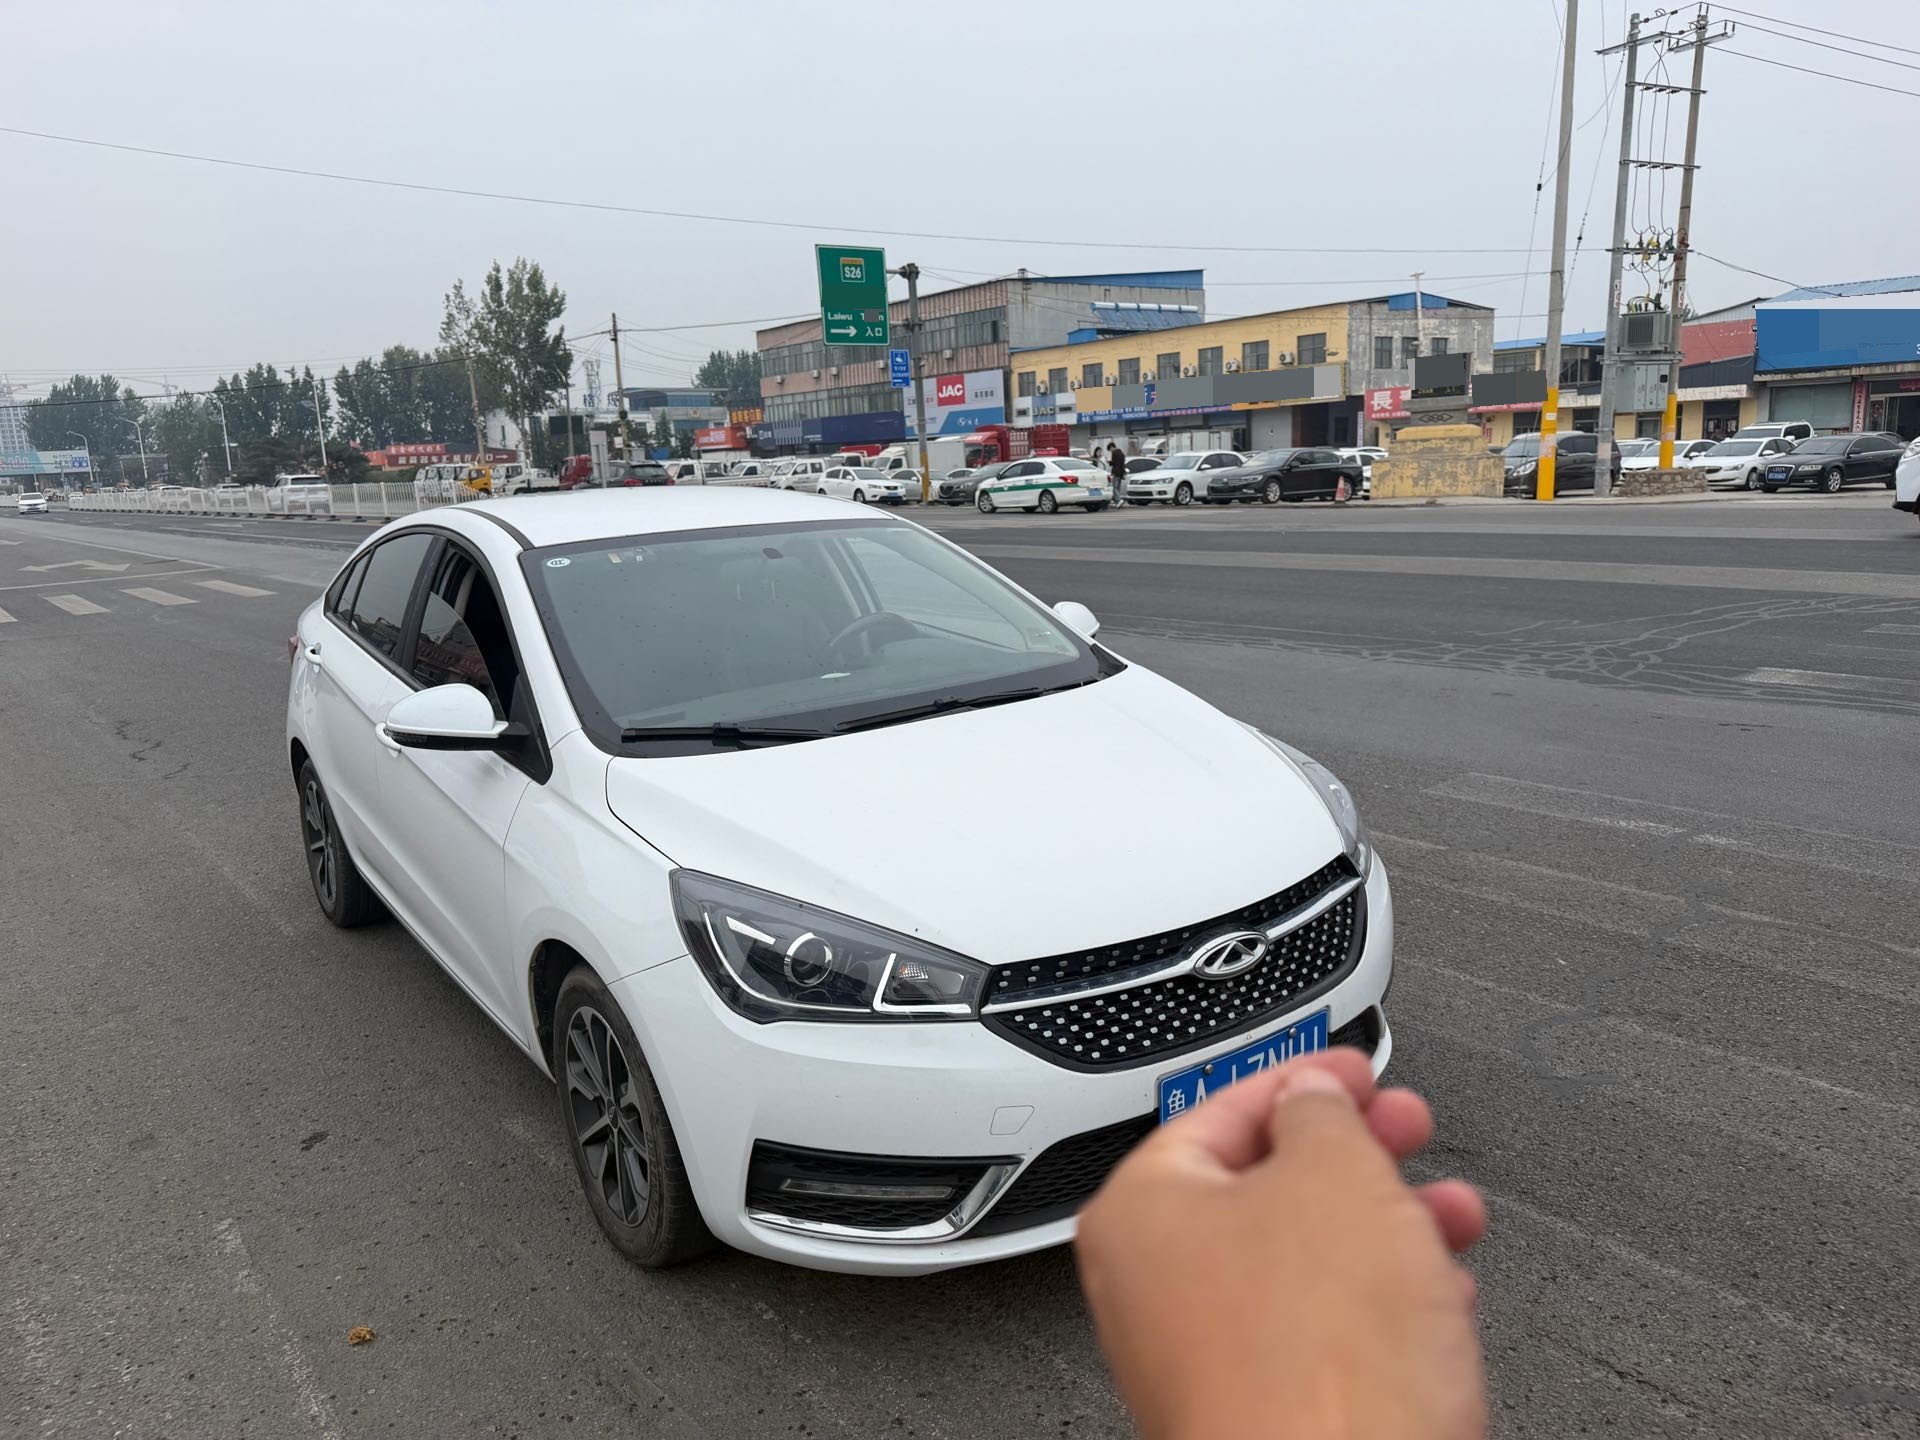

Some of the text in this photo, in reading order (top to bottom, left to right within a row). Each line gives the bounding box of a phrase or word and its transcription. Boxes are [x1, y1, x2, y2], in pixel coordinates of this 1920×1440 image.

[843, 266, 862, 279] S26
[827, 311, 853, 321] Laiwu
[865, 326, 883, 337] 入口
[938, 384, 963, 398] JAC
[1032, 405, 1056, 416] JAC
